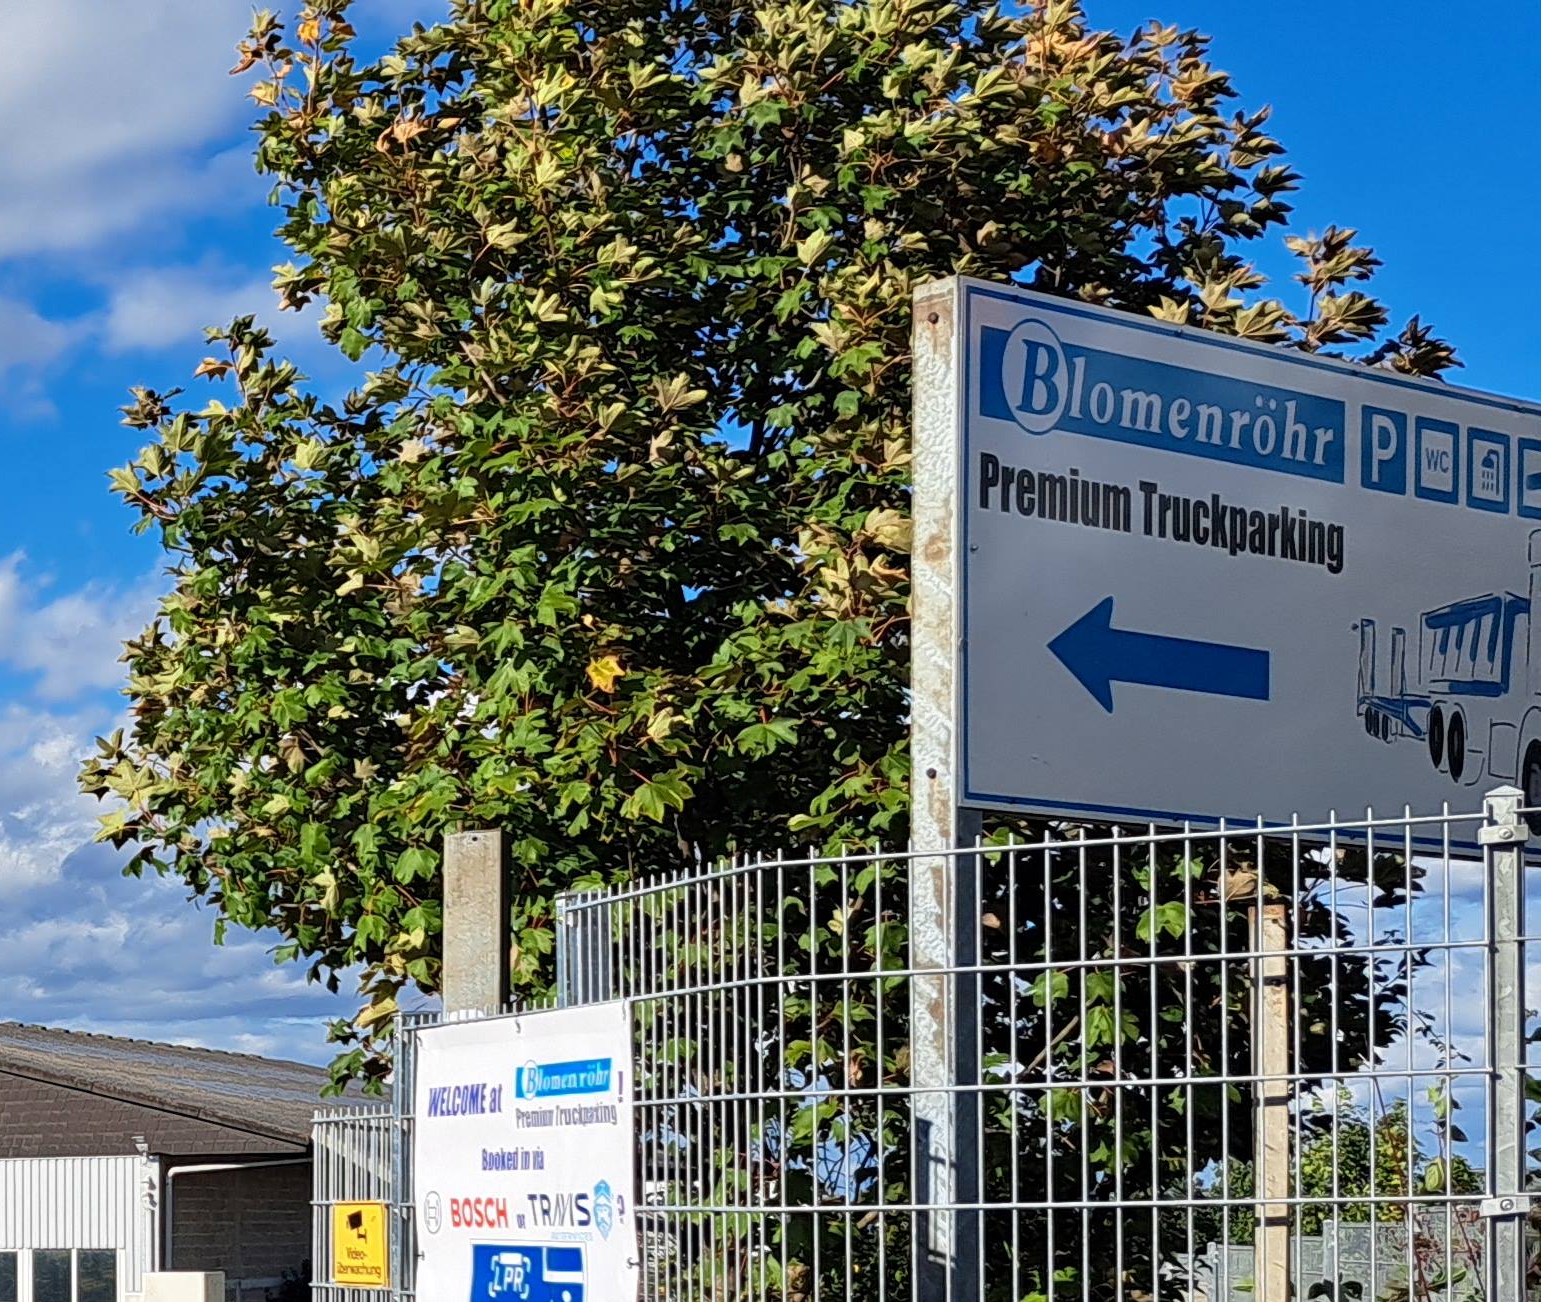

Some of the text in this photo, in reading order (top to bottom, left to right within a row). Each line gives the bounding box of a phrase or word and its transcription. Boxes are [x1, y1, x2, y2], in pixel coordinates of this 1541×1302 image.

[1013, 338, 1334, 467] Blomenröhr
[1371, 413, 1398, 483] P
[1424, 447, 1450, 474] WC
[980, 453, 1345, 574] Premium Truckparking
[427, 1083, 487, 1118] WELCOME
[489, 1084, 503, 1113] at
[515, 1106, 554, 1129] Premium
[481, 1146, 545, 1171] Booked in via
[450, 1197, 509, 1229] BOSCH
[493, 1266, 524, 1292] LPR
